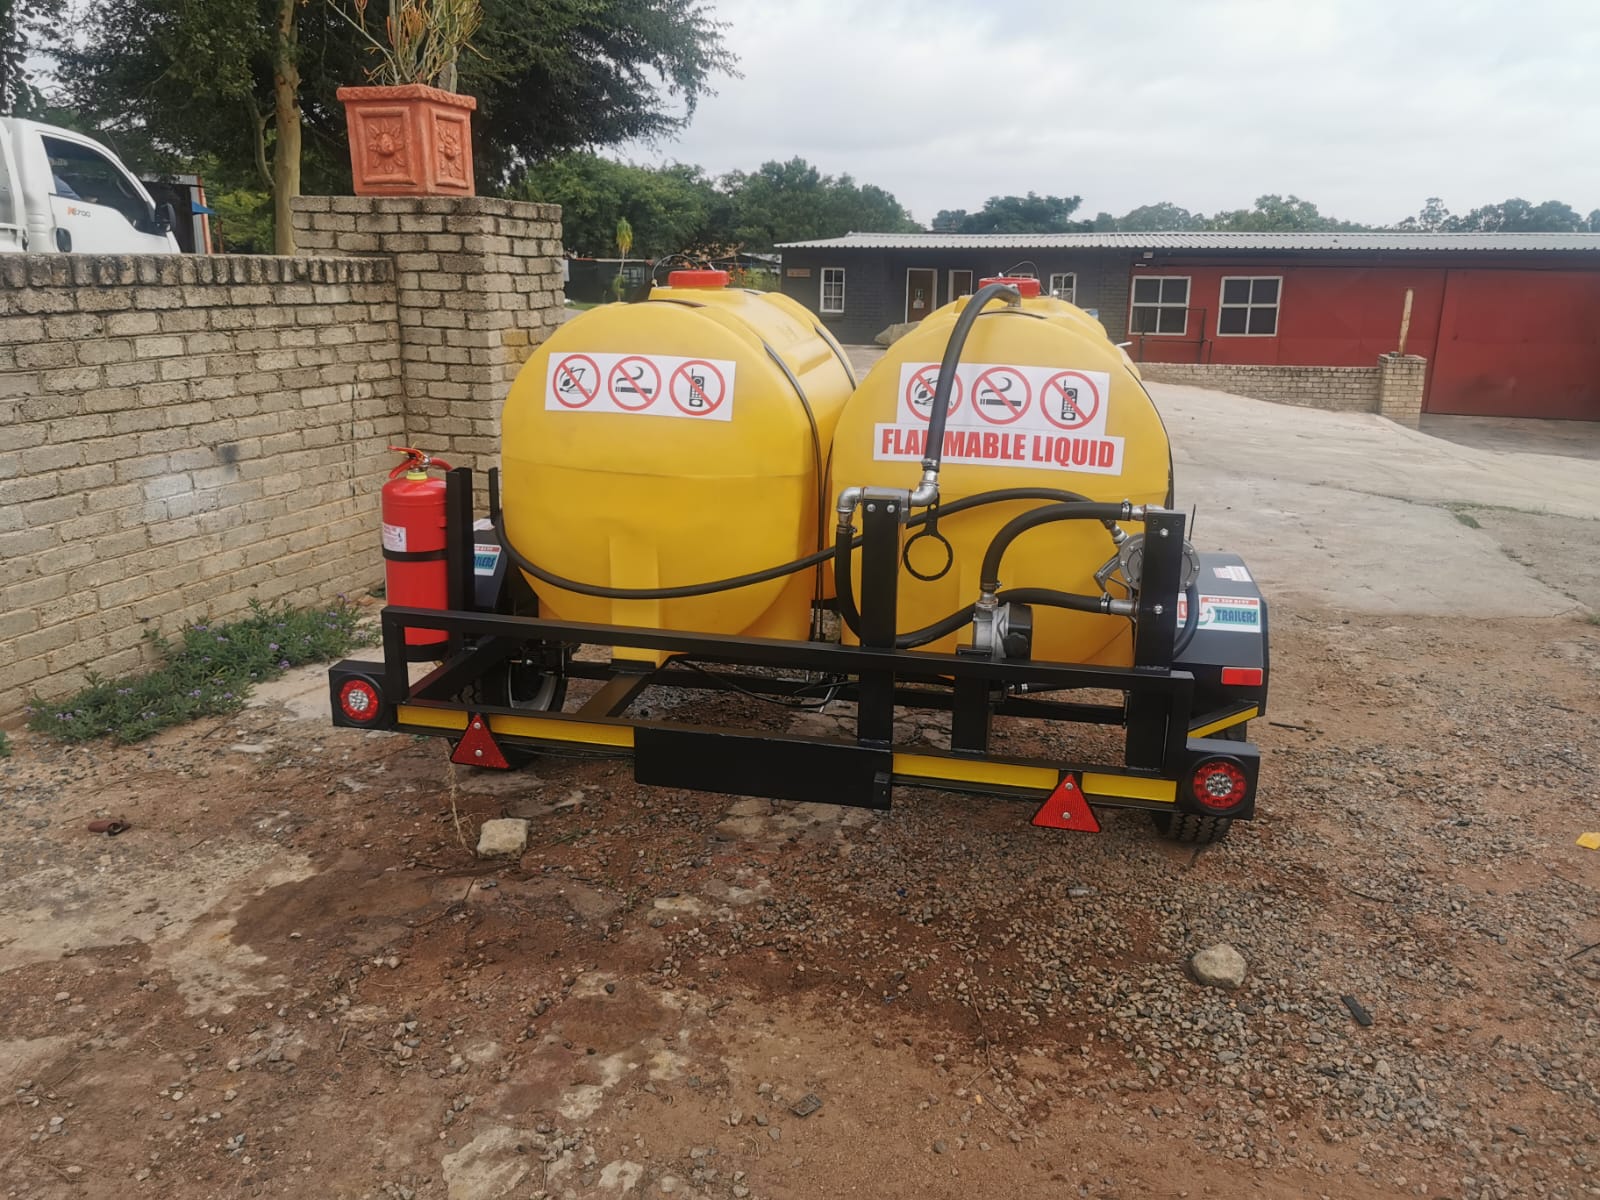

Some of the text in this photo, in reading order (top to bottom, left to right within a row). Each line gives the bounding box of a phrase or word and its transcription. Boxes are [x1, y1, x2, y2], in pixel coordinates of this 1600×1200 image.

[882, 428, 1115, 467] FLAMABLE LIQUID
[1215, 609, 1257, 624] TRAILERS
